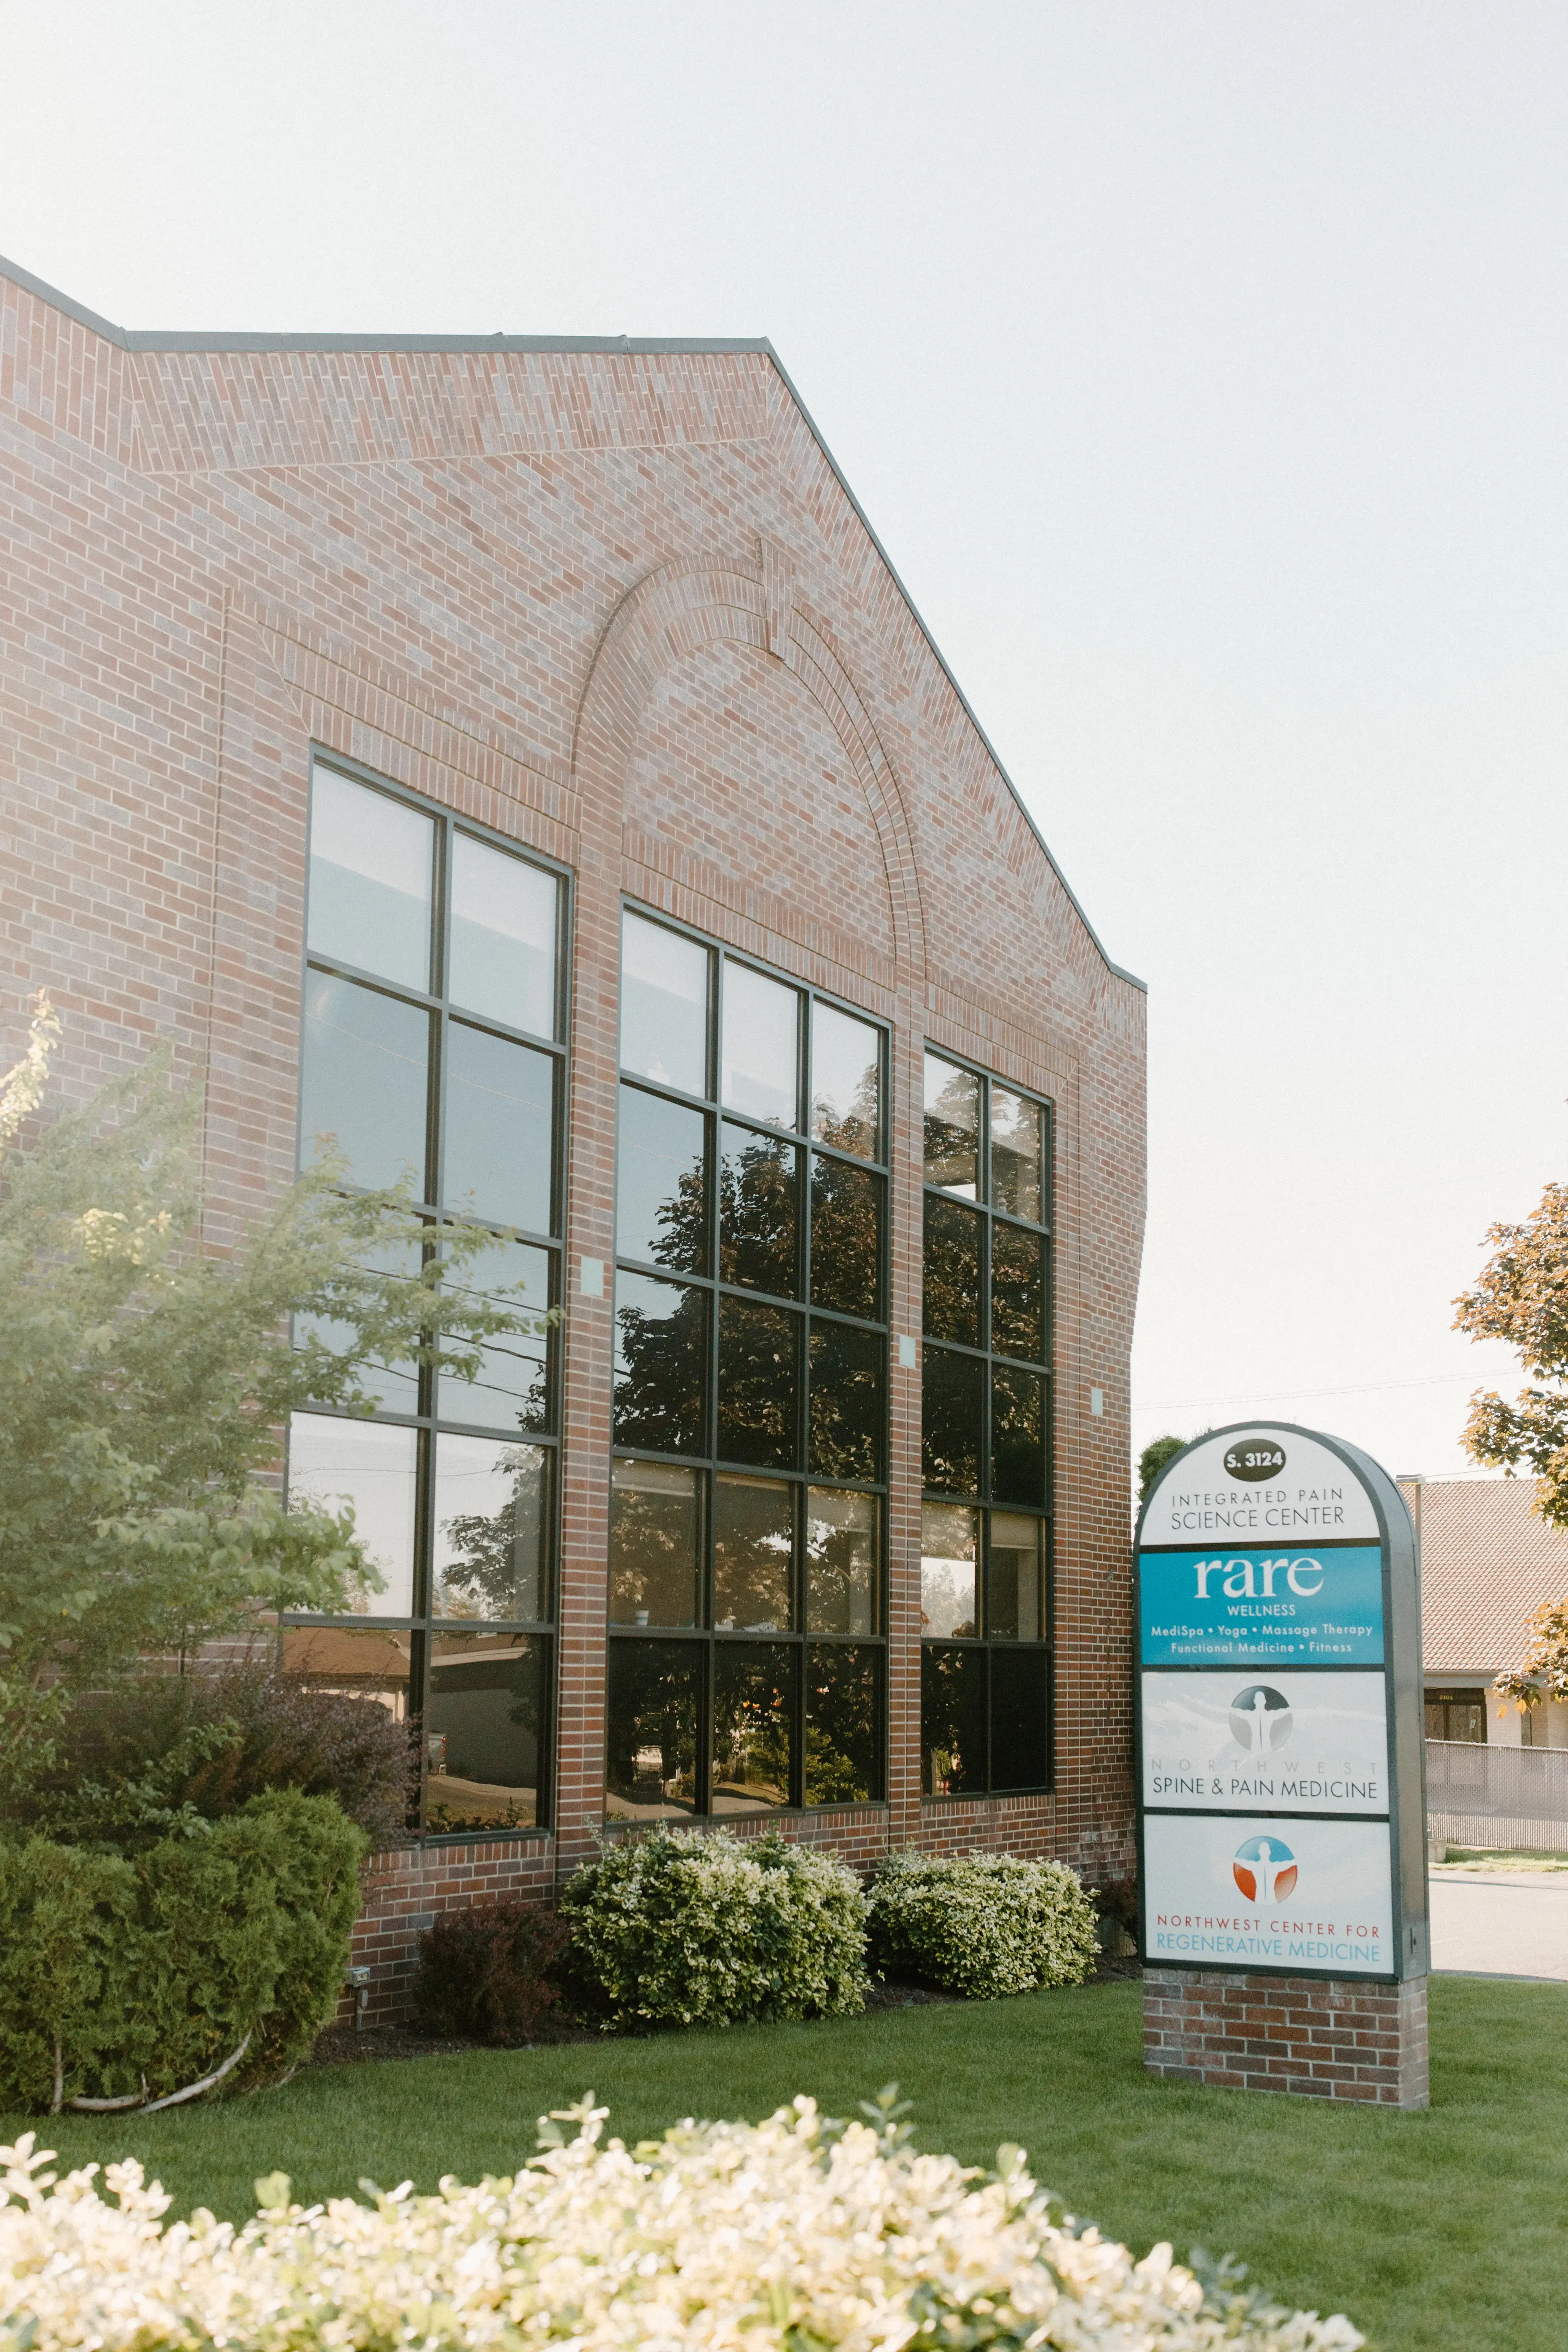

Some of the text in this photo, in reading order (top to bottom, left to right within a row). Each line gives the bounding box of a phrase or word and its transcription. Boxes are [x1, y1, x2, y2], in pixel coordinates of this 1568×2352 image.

[1227, 1452, 1282, 1467] S. 3124
[1172, 1488, 1343, 1507] INTEGRATED PAIN
[1171, 1507, 1344, 1530] SCIENCE CENTER
[1193, 1558, 1323, 1598] rare
[1228, 1604, 1296, 1616] WELLNESS
[1151, 1623, 1373, 1637] MediSpa Yoga Massage Therapy
[1171, 1641, 1351, 1653] Functional Medicine Fitness
[1152, 1759, 1378, 1775] NORTHWEST
[1153, 1777, 1377, 1798] SPINE & PAIN MEDICINE
[1158, 1915, 1379, 1938] NORTHWEST CENTER FOR
[1157, 1933, 1380, 1962] REGENERATIVE MEDICINE
